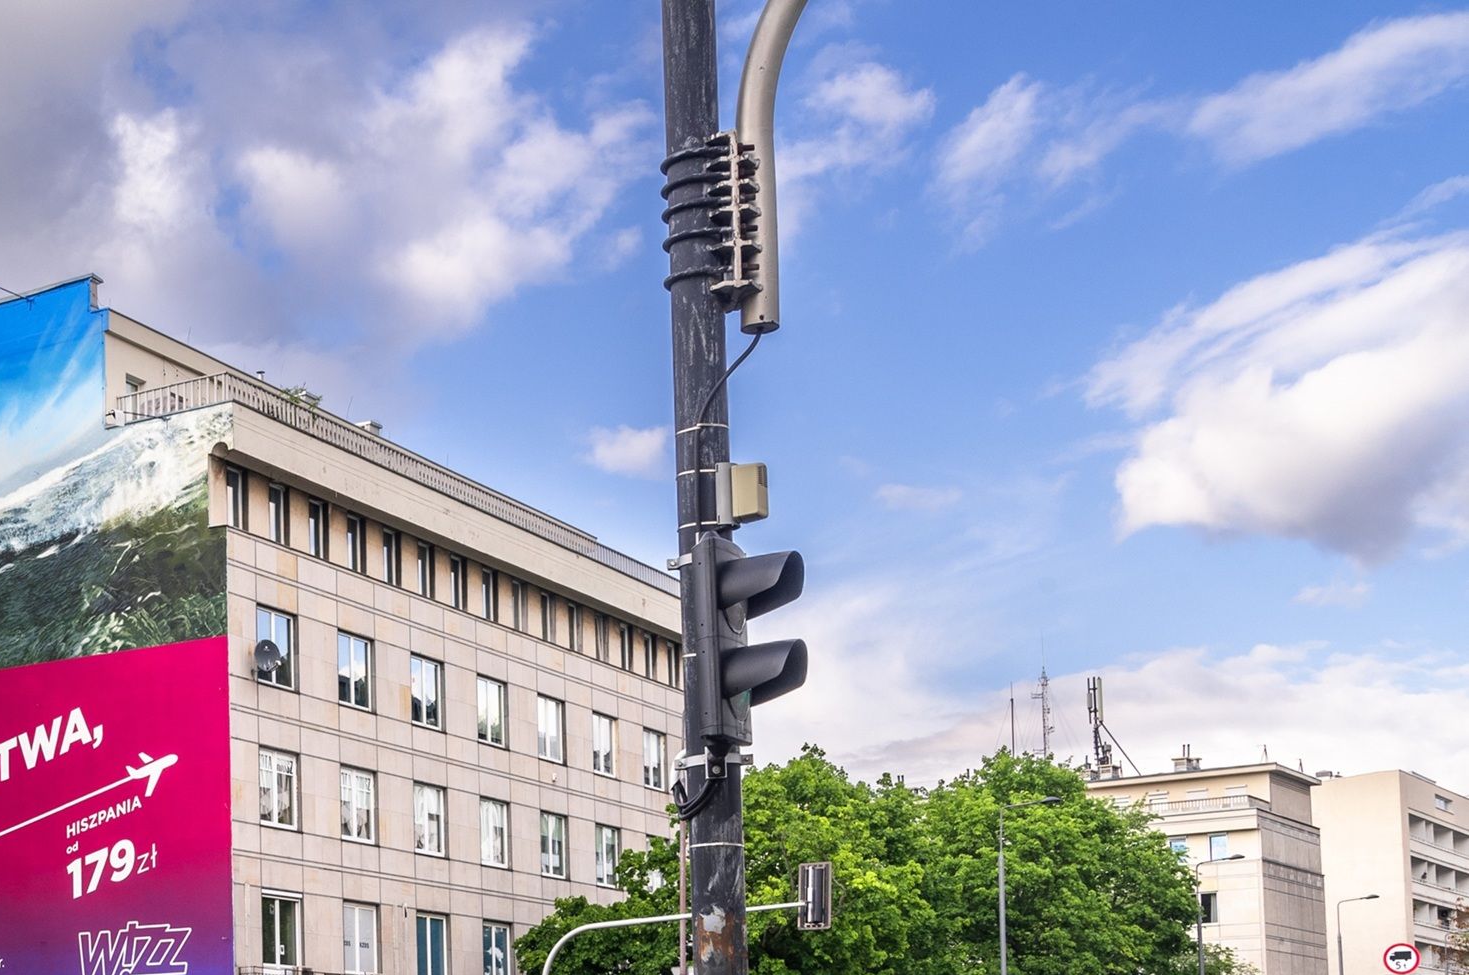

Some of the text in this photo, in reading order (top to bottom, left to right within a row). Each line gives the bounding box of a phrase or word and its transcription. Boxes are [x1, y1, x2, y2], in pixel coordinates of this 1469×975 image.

[66, 795, 142, 839] HISZPANIA
[66, 841, 79, 855] od
[66, 839, 158, 899] 179 zł
[1396, 961, 1402, 970] 5
